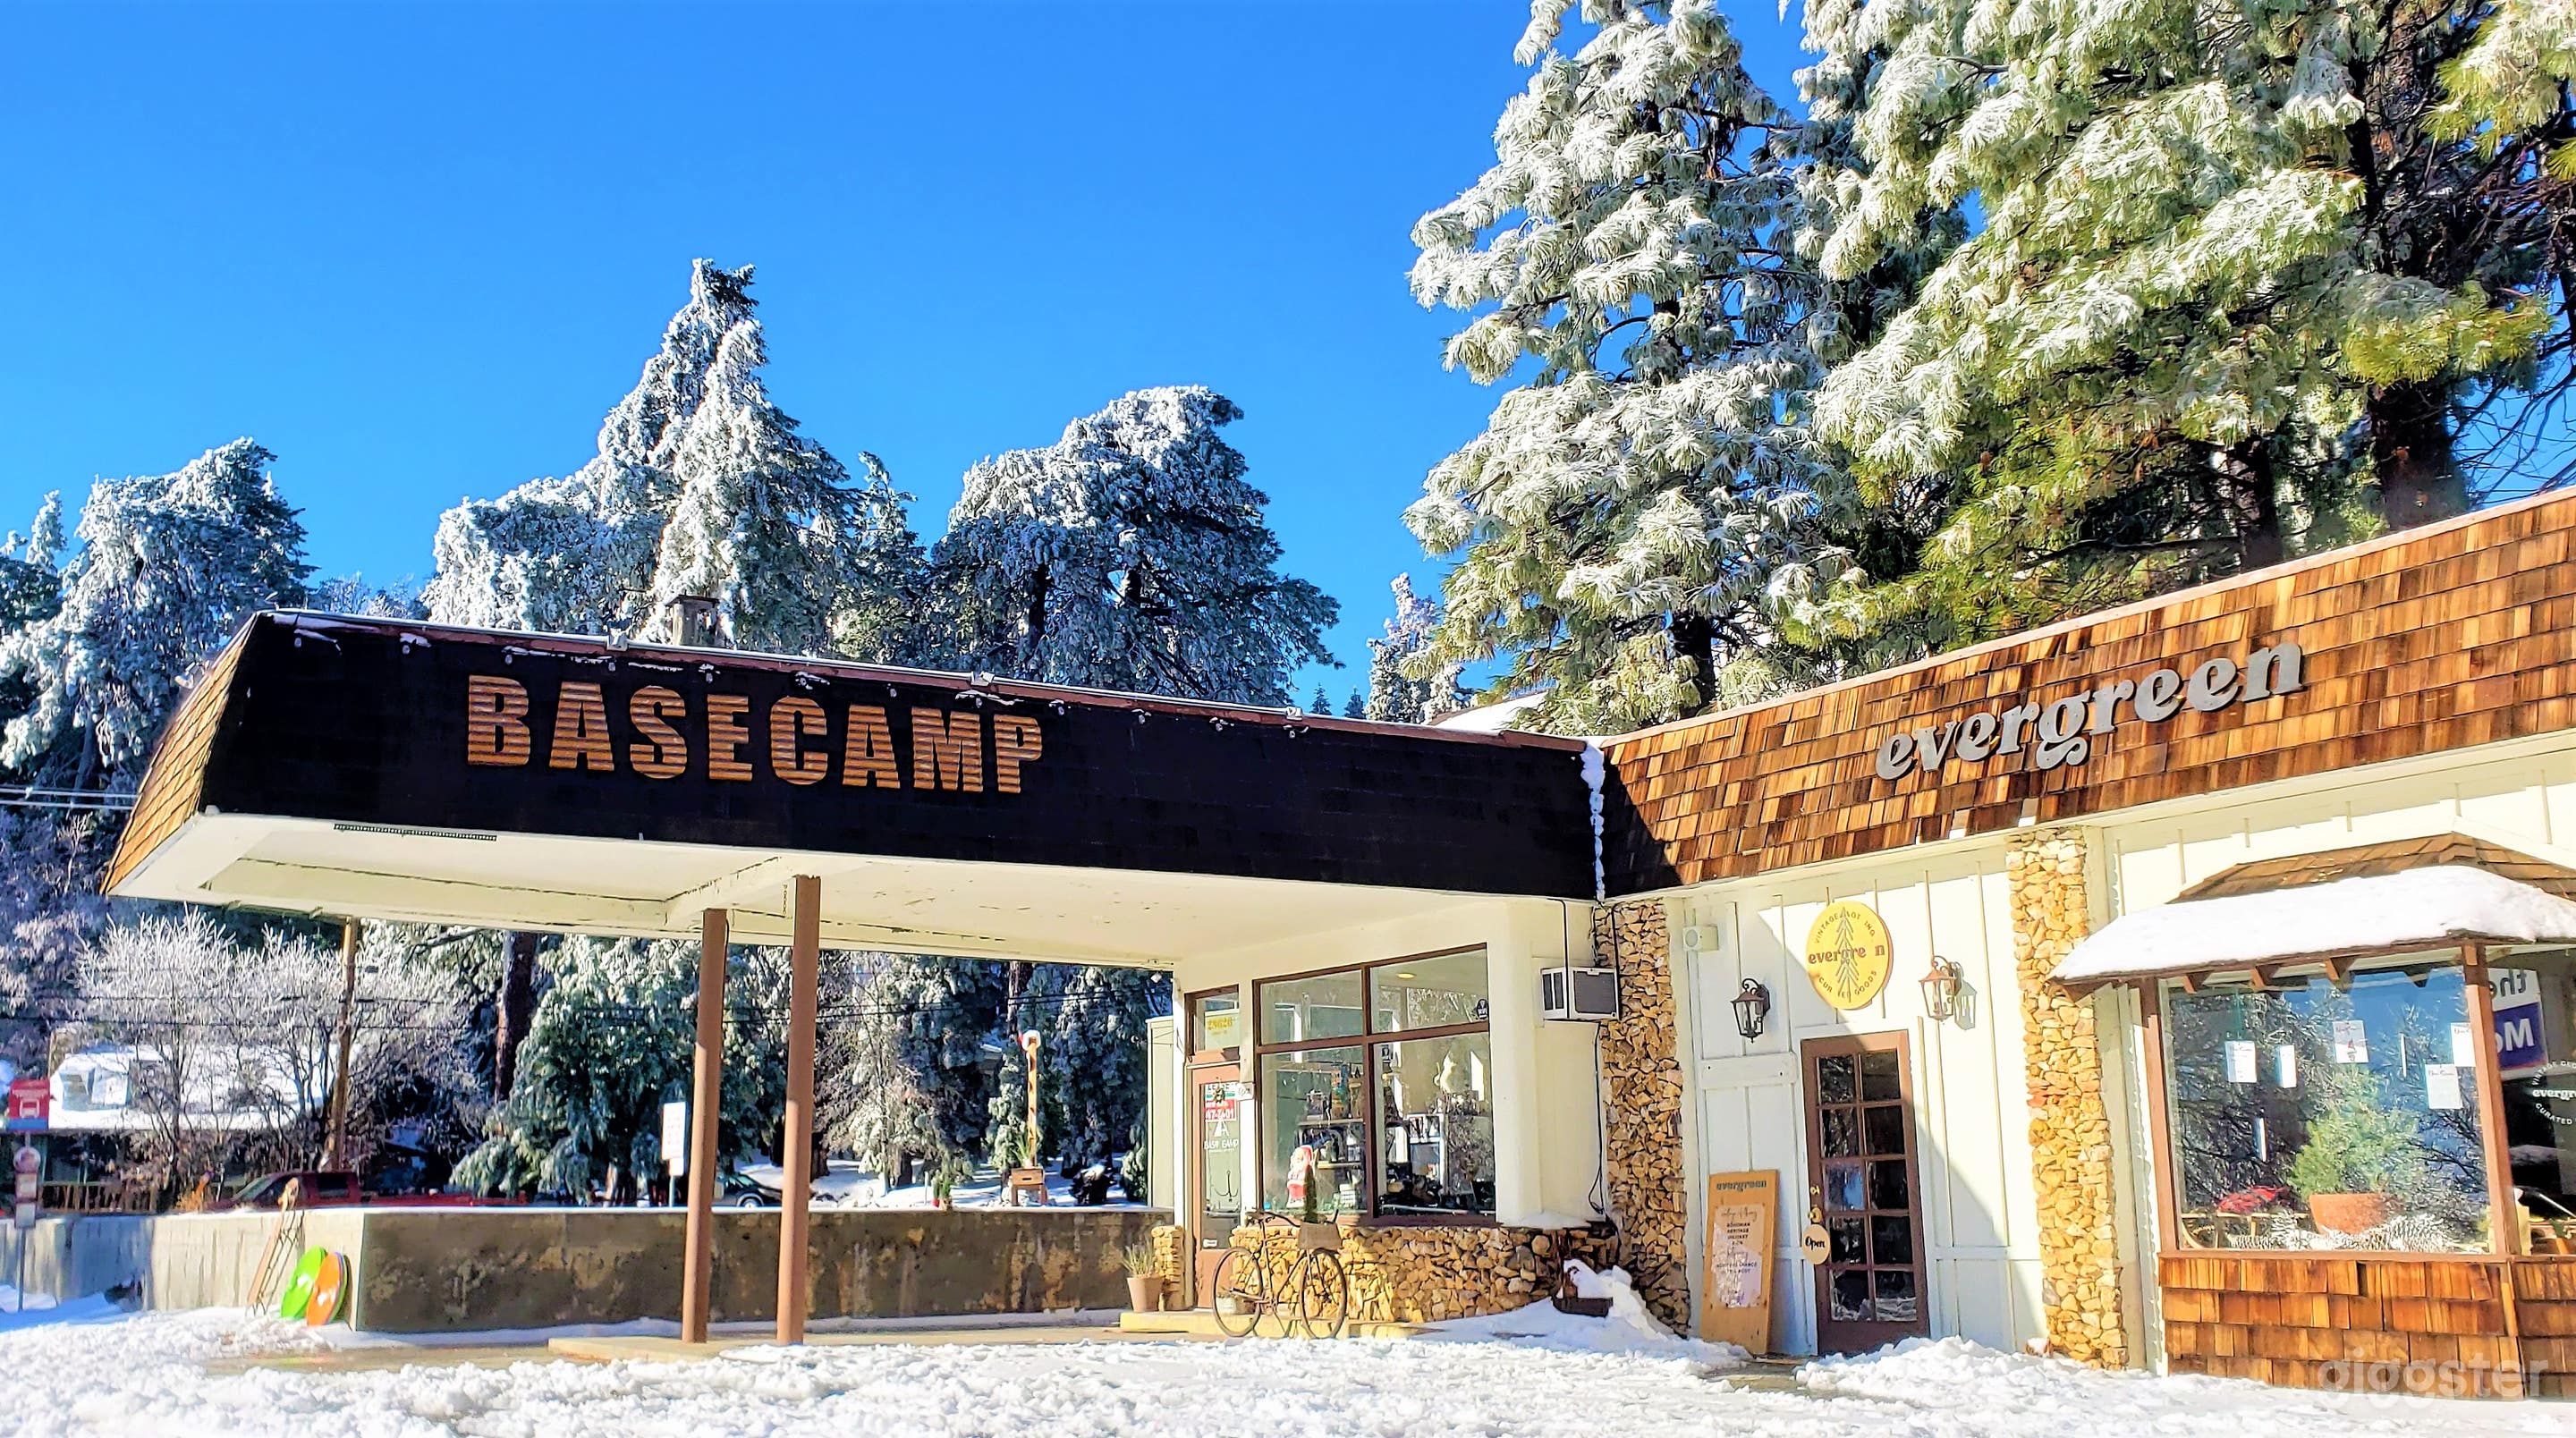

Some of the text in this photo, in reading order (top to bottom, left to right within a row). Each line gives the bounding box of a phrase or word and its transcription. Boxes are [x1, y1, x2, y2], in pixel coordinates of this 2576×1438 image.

[1876, 640, 2308, 781] evergreen
[467, 674, 1043, 794] BASECAMP
[1808, 944, 1885, 968] evergren
[2535, 1103, 2572, 1125] CURATED
[1716, 1180, 1767, 1192] evergreen
[1805, 1235, 1826, 1251] Open
